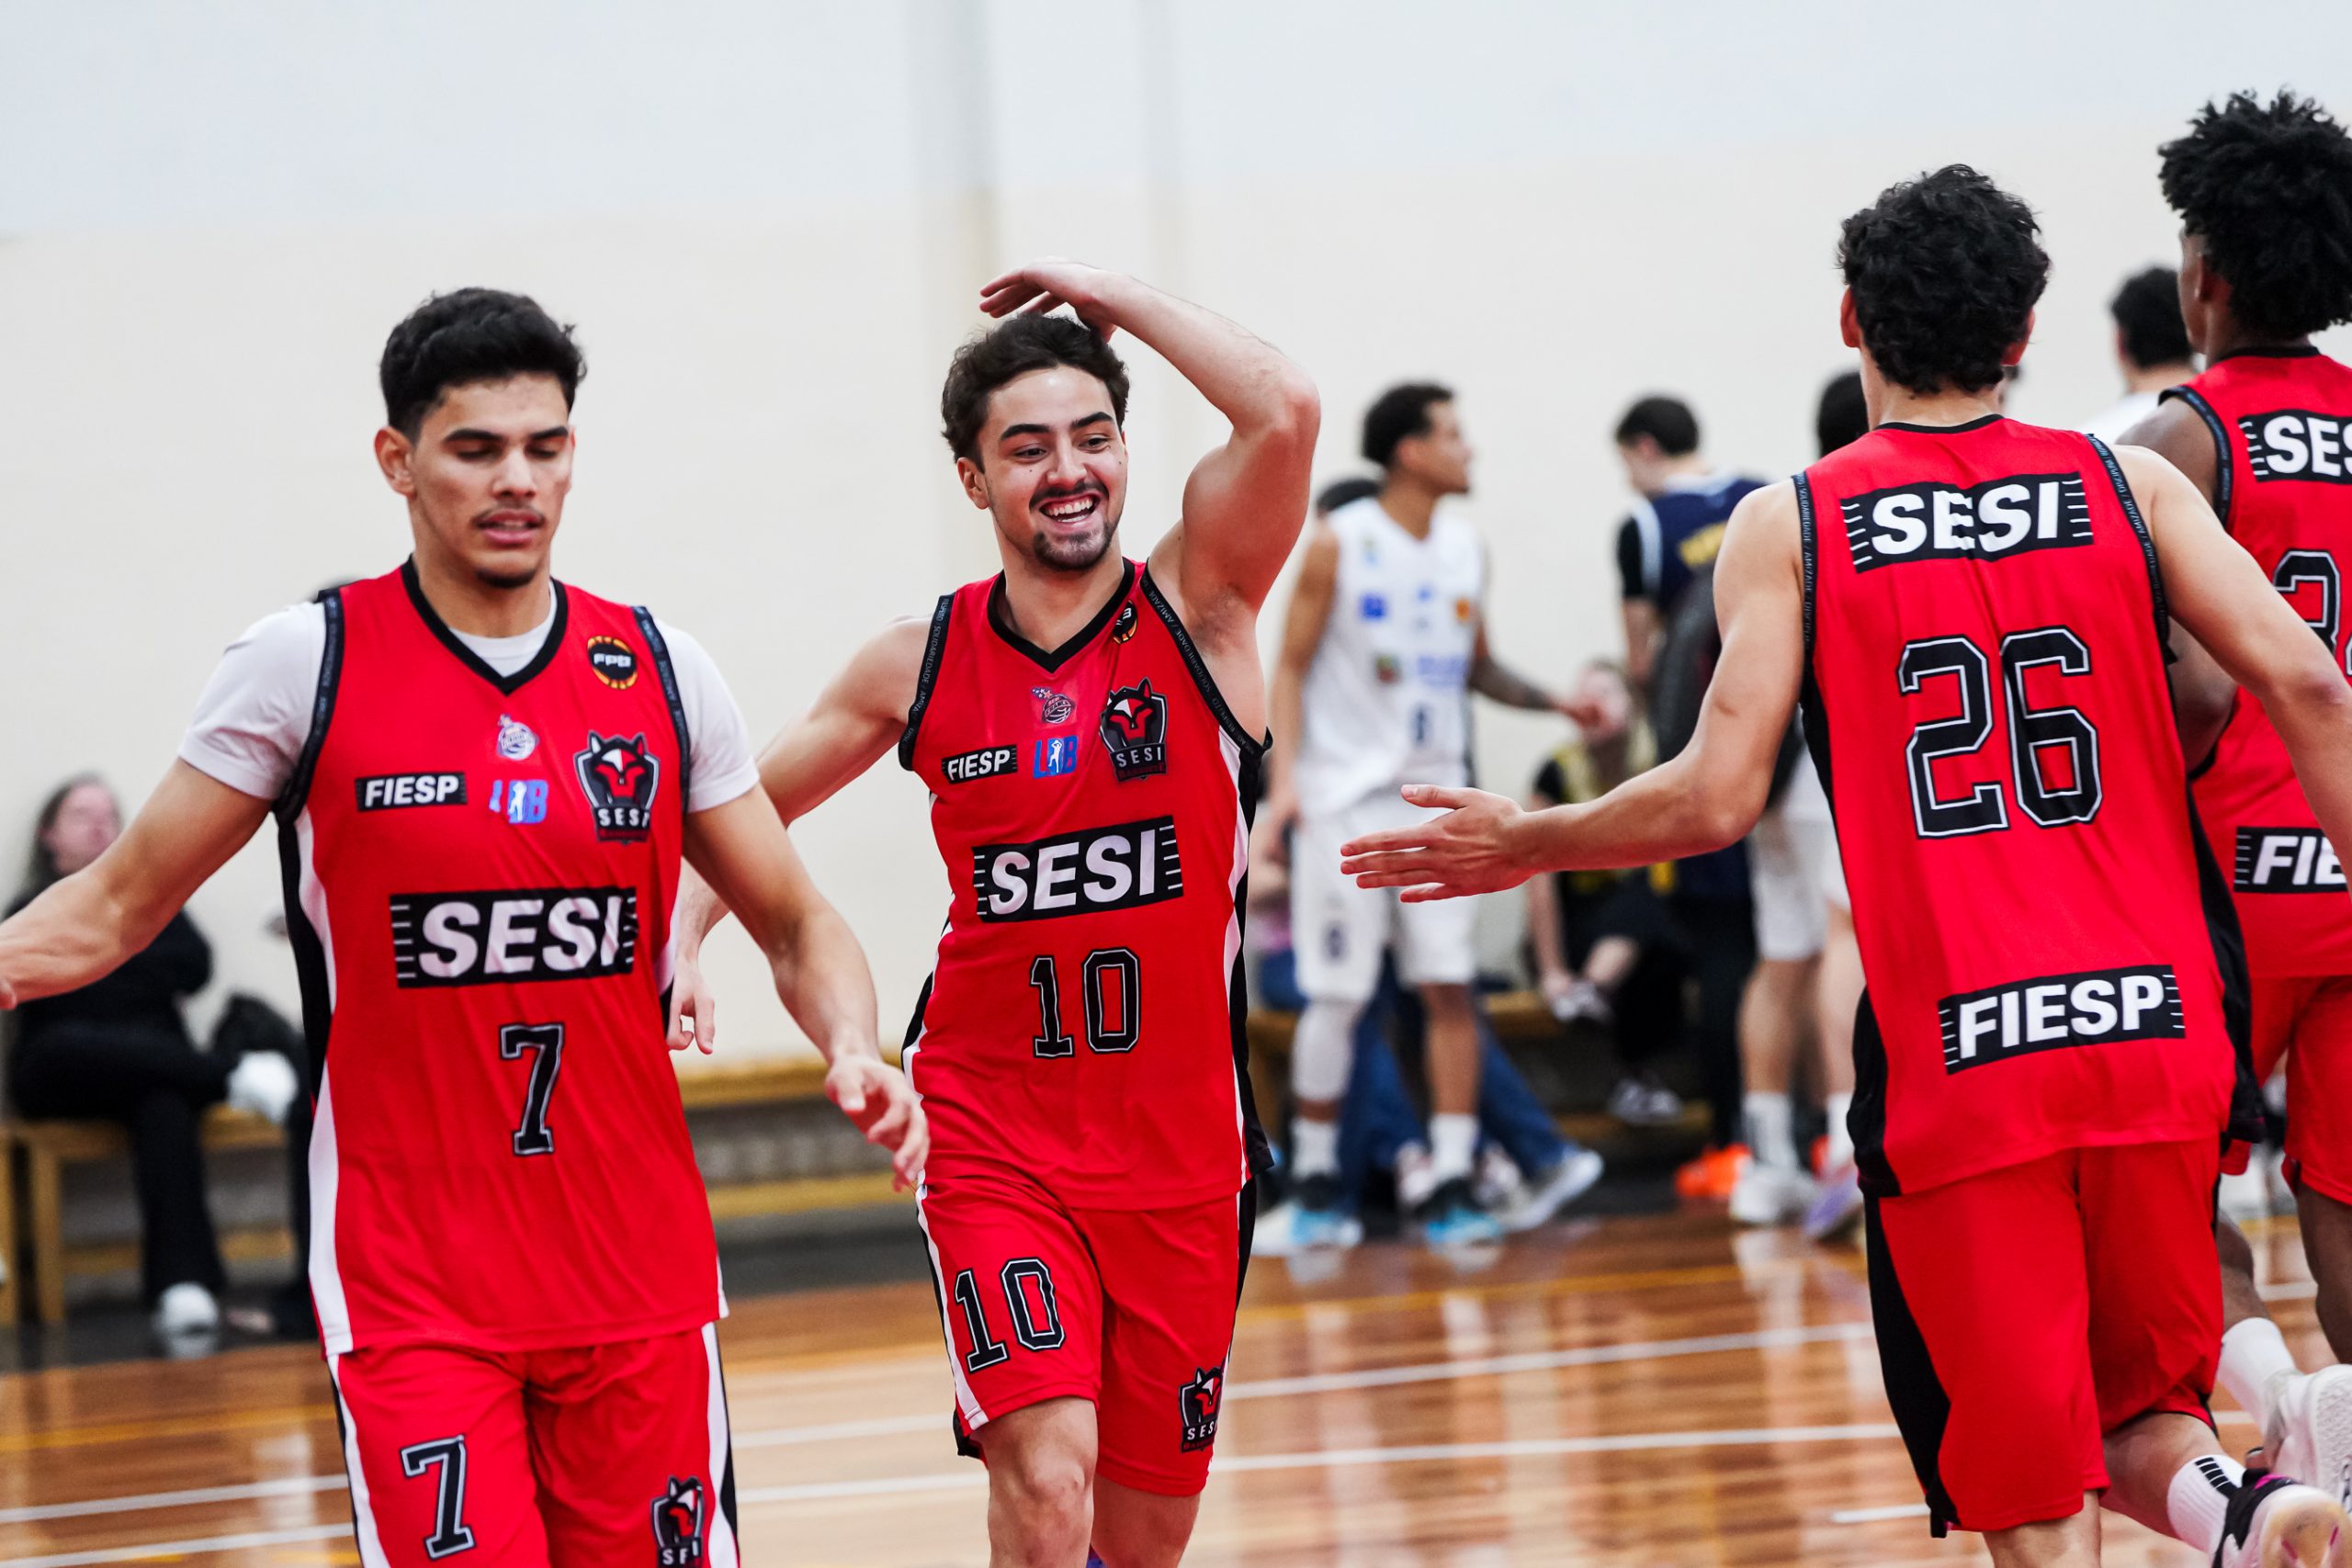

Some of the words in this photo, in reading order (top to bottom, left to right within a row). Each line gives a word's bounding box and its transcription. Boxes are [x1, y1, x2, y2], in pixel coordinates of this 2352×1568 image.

[1871, 480, 2060, 556] SESI
[947, 748, 1011, 782] FIESP
[1115, 746, 1162, 768] SESI
[1897, 625, 2103, 840] 26
[364, 774, 460, 807] FIESP
[597, 807, 650, 829] SESI
[988, 829, 1156, 915] SESI
[418, 895, 623, 978] SESI
[1029, 947, 1142, 1059] 10
[1958, 974, 2165, 1059] FIESP
[499, 1021, 565, 1157] 7
[953, 1256, 1067, 1373] 10
[401, 1434, 477, 1562] 7
